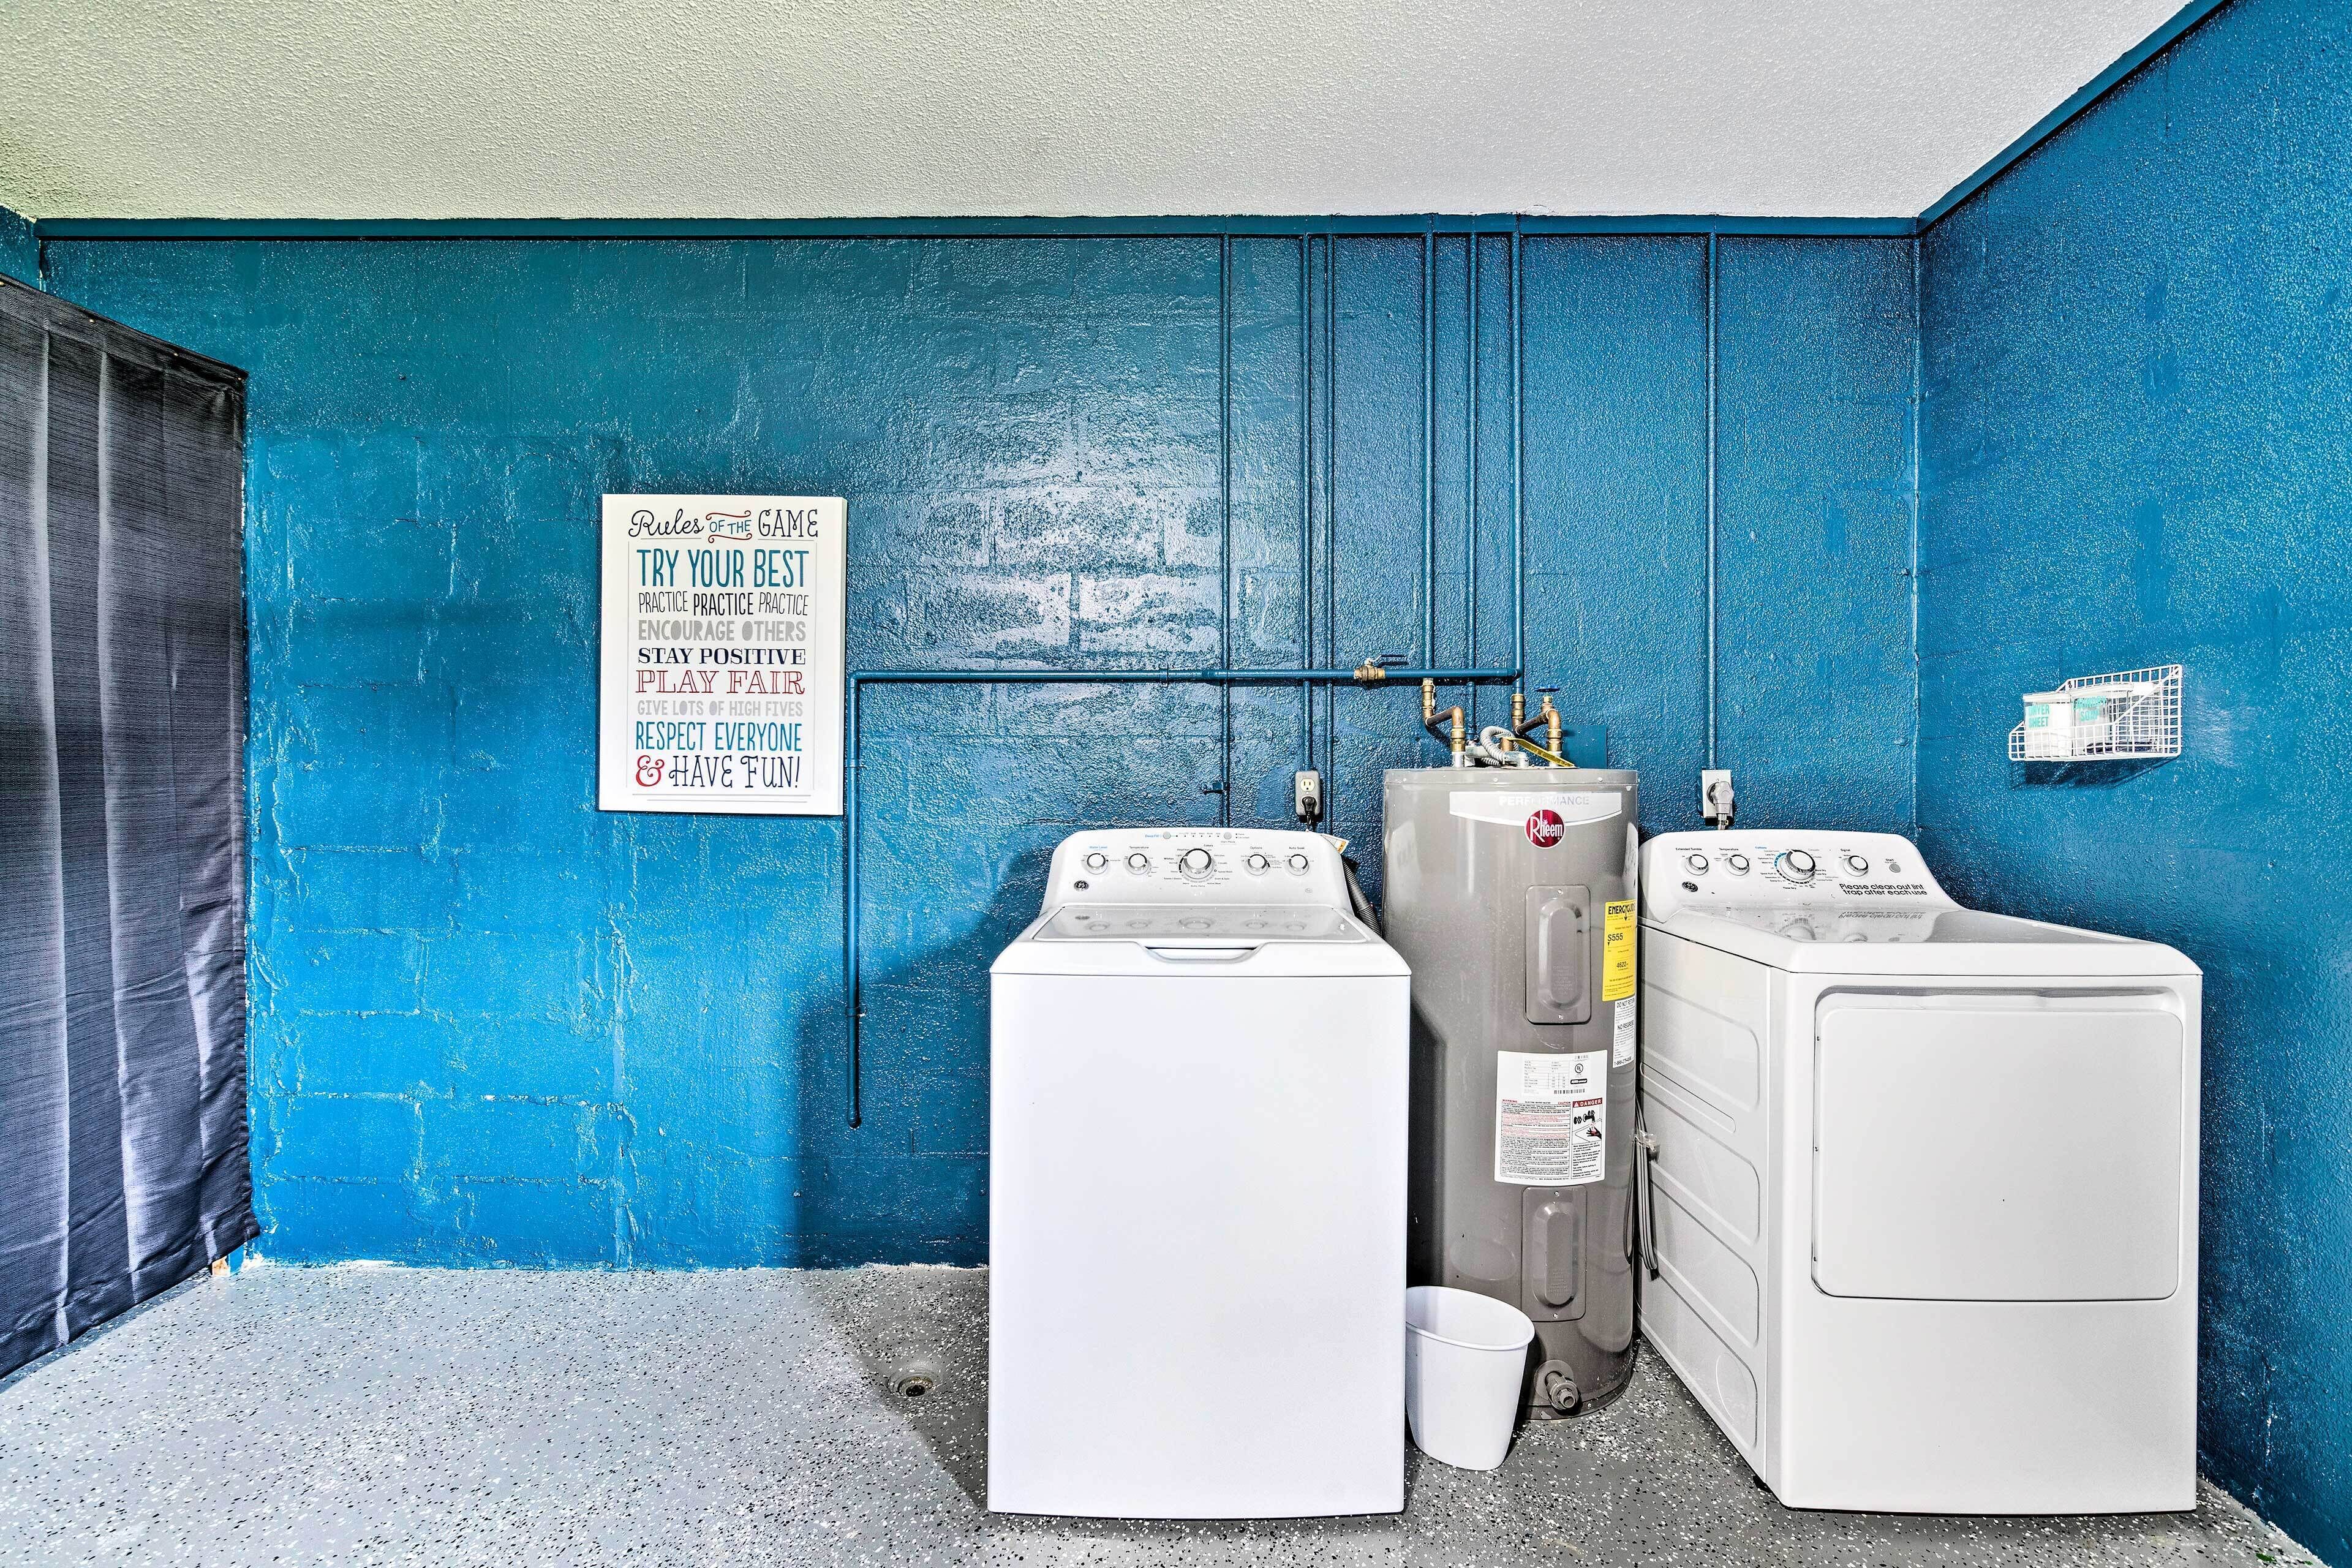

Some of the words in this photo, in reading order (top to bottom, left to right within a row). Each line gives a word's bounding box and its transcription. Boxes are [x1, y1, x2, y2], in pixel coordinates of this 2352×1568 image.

[628, 508, 704, 537] Rules
[709, 519, 725, 533] OF
[727, 519, 752, 535] THE
[758, 508, 818, 537] GAME
[636, 548, 679, 587] TRY
[687, 549, 744, 588] YOUR
[754, 549, 809, 588] BEST
[639, 591, 688, 613] PRACTICE
[693, 592, 753, 616] PRACTICE
[759, 592, 809, 616] PRACTICE
[639, 620, 735, 641] ENCOURAGE
[742, 621, 805, 641] OTHERS
[638, 647, 693, 664] STAY
[699, 648, 805, 665] POSITIVE
[635, 670, 720, 693] PLAY
[726, 671, 805, 695] FAIR
[638, 700, 668, 715] GIVE
[673, 701, 703, 715] LOTS
[709, 701, 724, 715] OF
[730, 701, 760, 715] HIGH
[766, 701, 802, 716] FIVES
[636, 721, 706, 750] RESPECT
[715, 722, 802, 752] EVERYONE
[636, 755, 665, 787] &
[669, 755, 733, 788] HAVE
[741, 755, 800, 788] FUN!
[1499, 796, 1589, 805] PERFORMANCE
[1529, 810, 1563, 842] Rheem
[1607, 933, 1623, 941] $555
